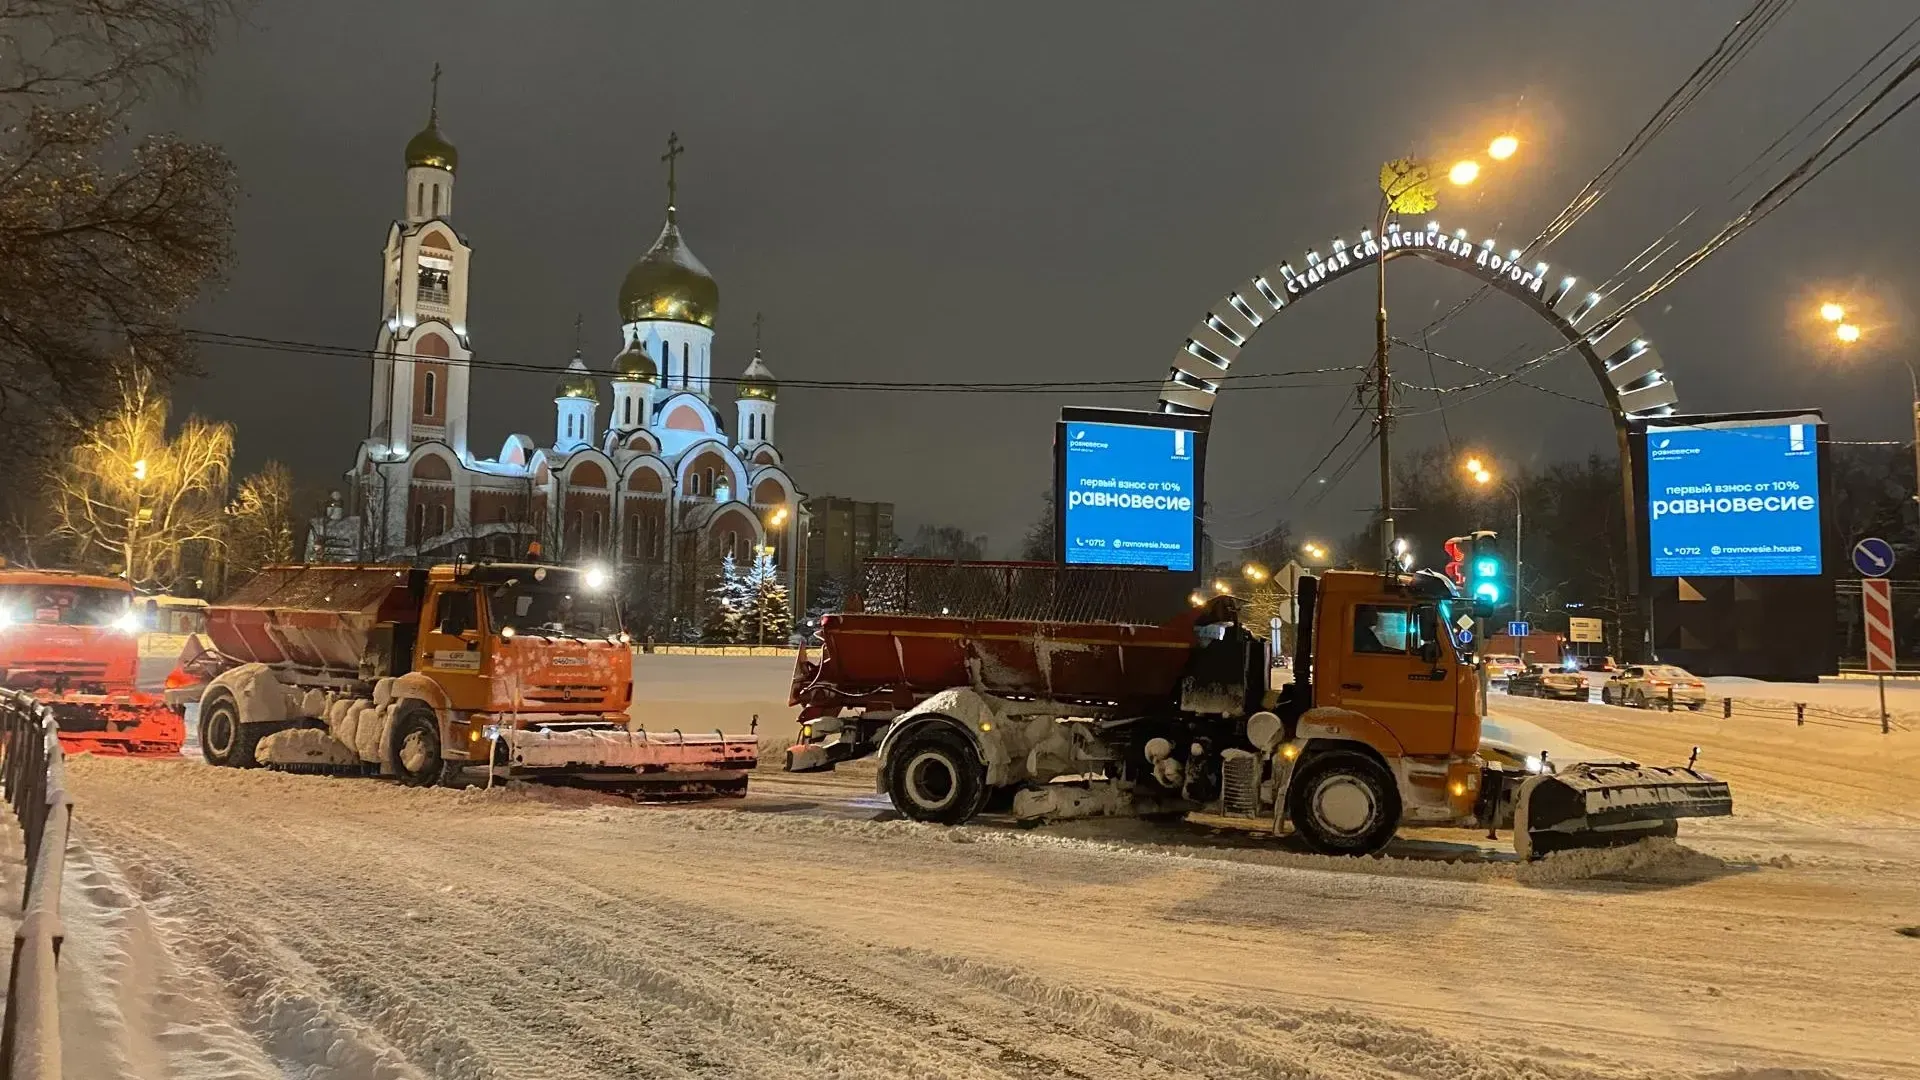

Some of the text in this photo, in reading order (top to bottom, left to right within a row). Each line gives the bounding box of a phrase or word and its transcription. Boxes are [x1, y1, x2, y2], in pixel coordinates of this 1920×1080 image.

[1287, 231, 1543, 293] СТАРАЯ СМОЛЕНСКАЯ ДОРОГА
[1080, 478, 1181, 492] первый взнос от 10%
[1666, 480, 1800, 496] первый взнос от 10%
[1069, 491, 1191, 512] равновесие
[1653, 495, 1815, 520] равновесие
[1122, 540, 1181, 550] ravnovesie.house
[1722, 545, 1802, 553] ravnovesie.house
